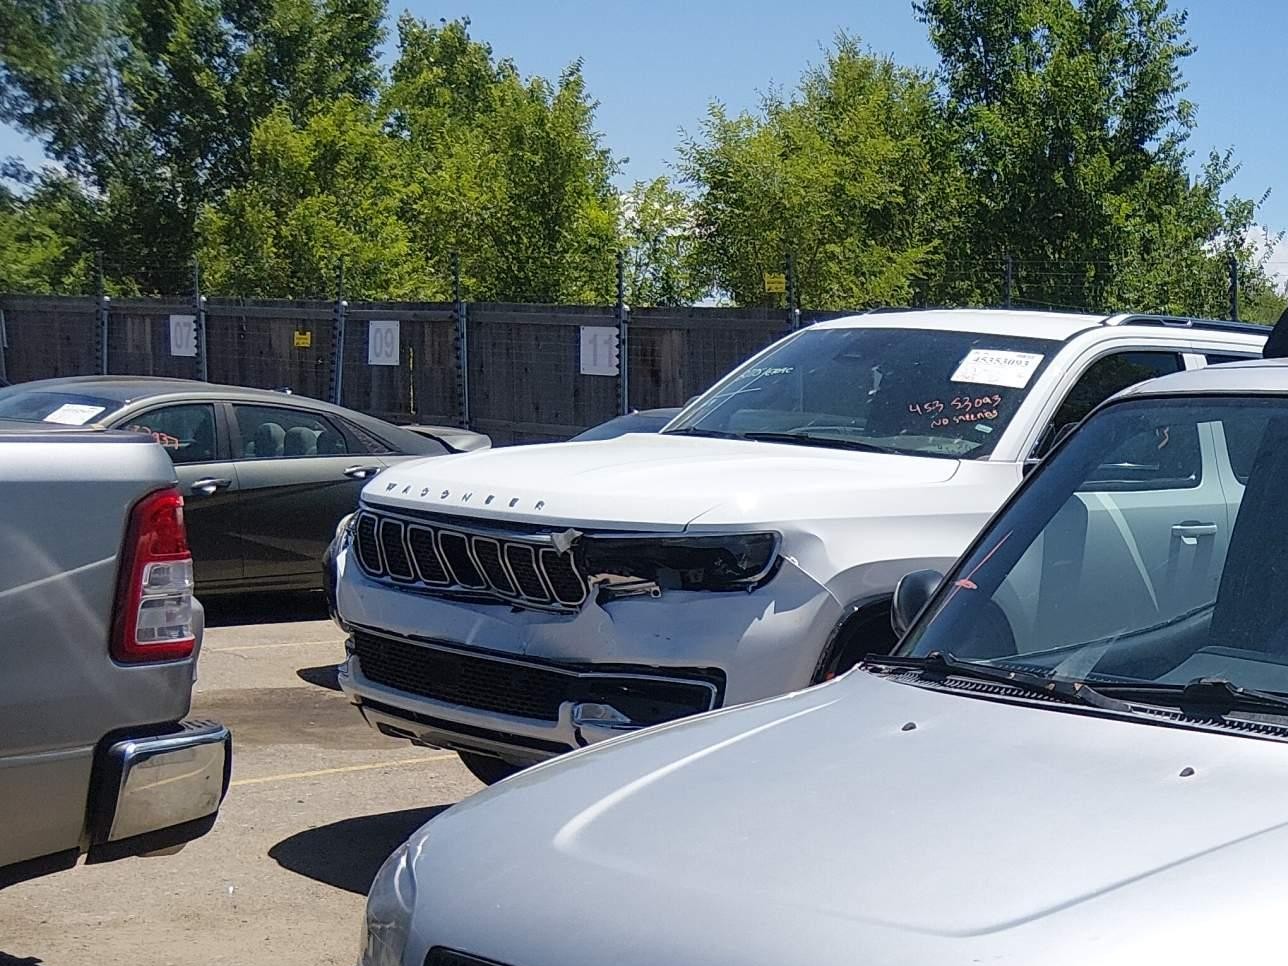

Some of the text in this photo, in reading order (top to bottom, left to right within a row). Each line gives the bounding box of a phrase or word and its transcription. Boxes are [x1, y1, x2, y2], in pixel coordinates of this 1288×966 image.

[174, 322, 192, 349] 07
[373, 327, 394, 358] 09
[588, 334, 614, 368] 11
[385, 482, 545, 511] WAGONEER
